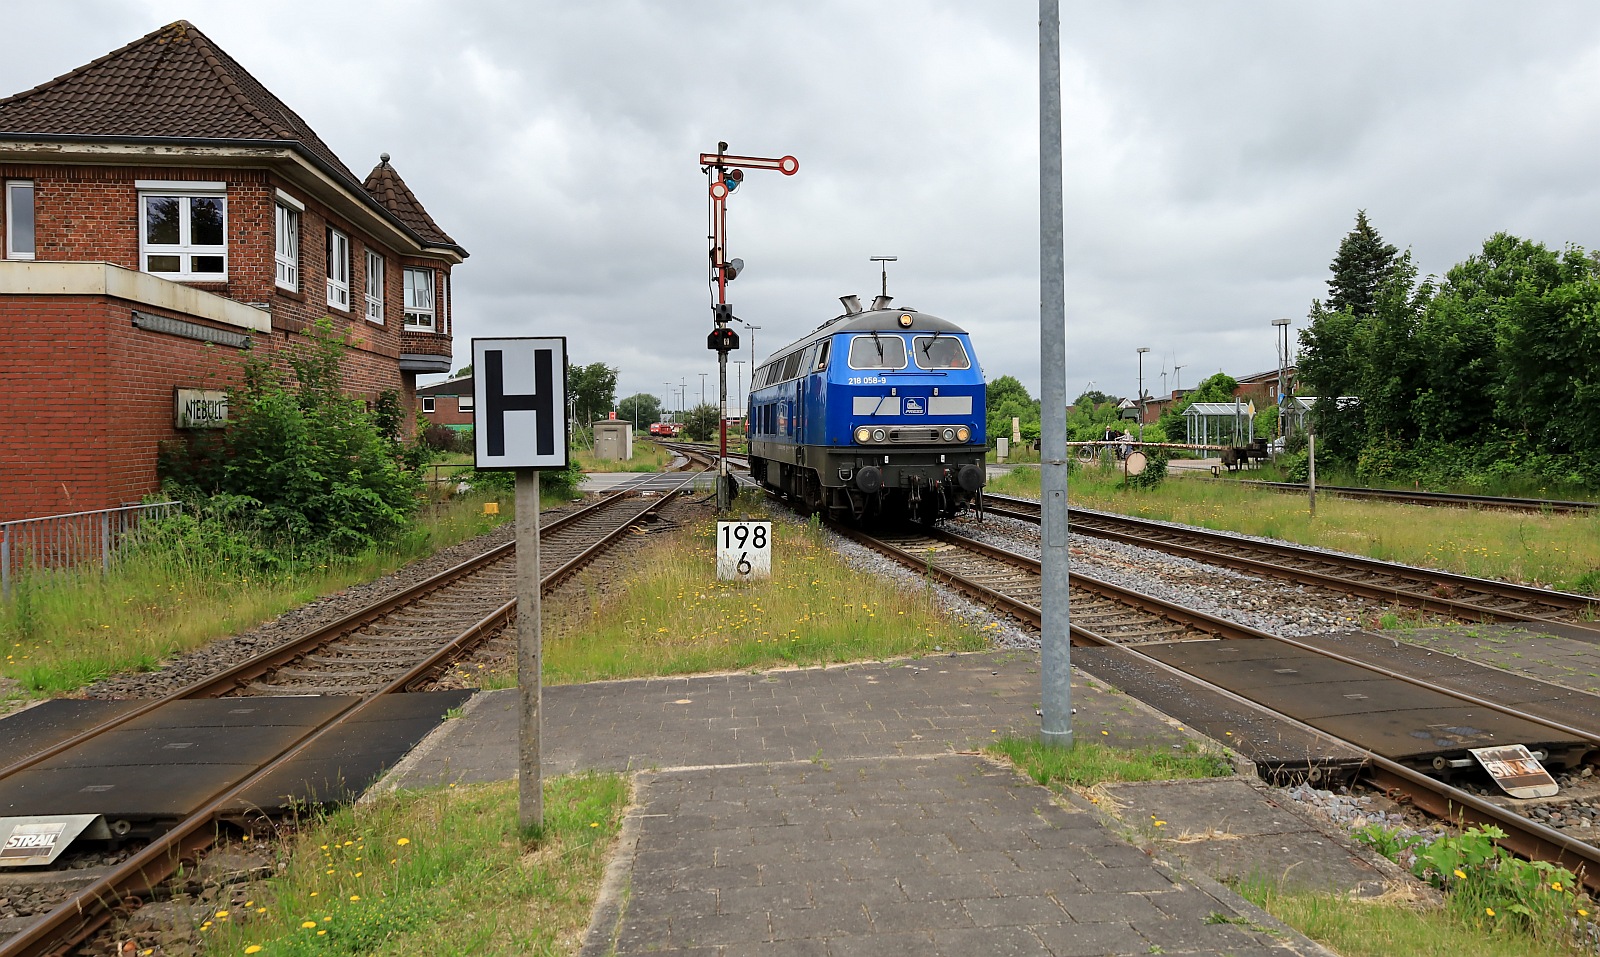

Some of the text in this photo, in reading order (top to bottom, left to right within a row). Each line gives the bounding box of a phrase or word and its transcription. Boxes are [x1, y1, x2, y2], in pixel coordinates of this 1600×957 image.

[848, 376, 887, 385] 218 058-9
[484, 349, 555, 457] H
[722, 525, 767, 549] 198
[736, 551, 752, 576] 6
[6, 833, 58, 849] STRAIL
